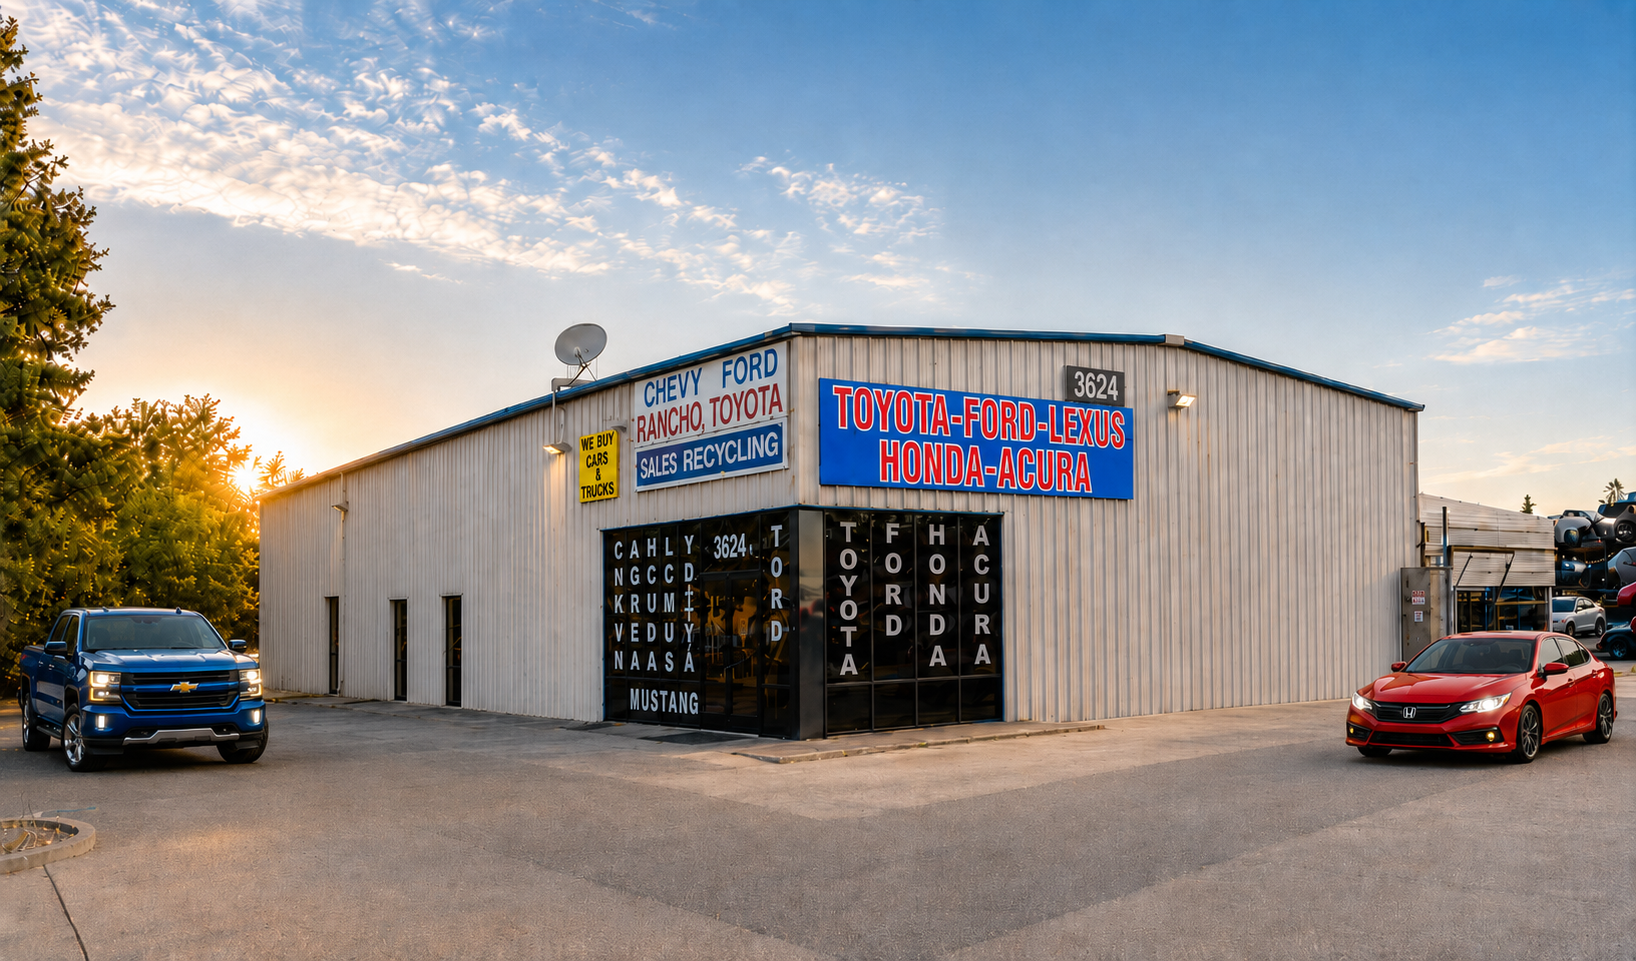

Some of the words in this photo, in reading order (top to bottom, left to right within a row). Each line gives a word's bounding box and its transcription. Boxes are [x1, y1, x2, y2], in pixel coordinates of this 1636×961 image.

[644, 367, 702, 408] CHEVY
[722, 348, 778, 388] FORD
[1074, 370, 1119, 401] 3624
[637, 401, 705, 443] RANCHO,
[709, 383, 783, 427] TOYOTA
[581, 437, 594, 451] WE
[597, 431, 614, 448] BUY
[586, 451, 609, 468] CARS
[640, 454, 677, 479] SALES
[683, 432, 779, 472] RECYCLING
[581, 482, 614, 499] TRUCKS
[595, 468, 601, 481] &
[839, 521, 858, 676] TOYOTA
[884, 522, 903, 637] FORD
[928, 524, 947, 667] HONDA
[972, 525, 991, 665] ACURA
[630, 688, 699, 715] MUSTANG
